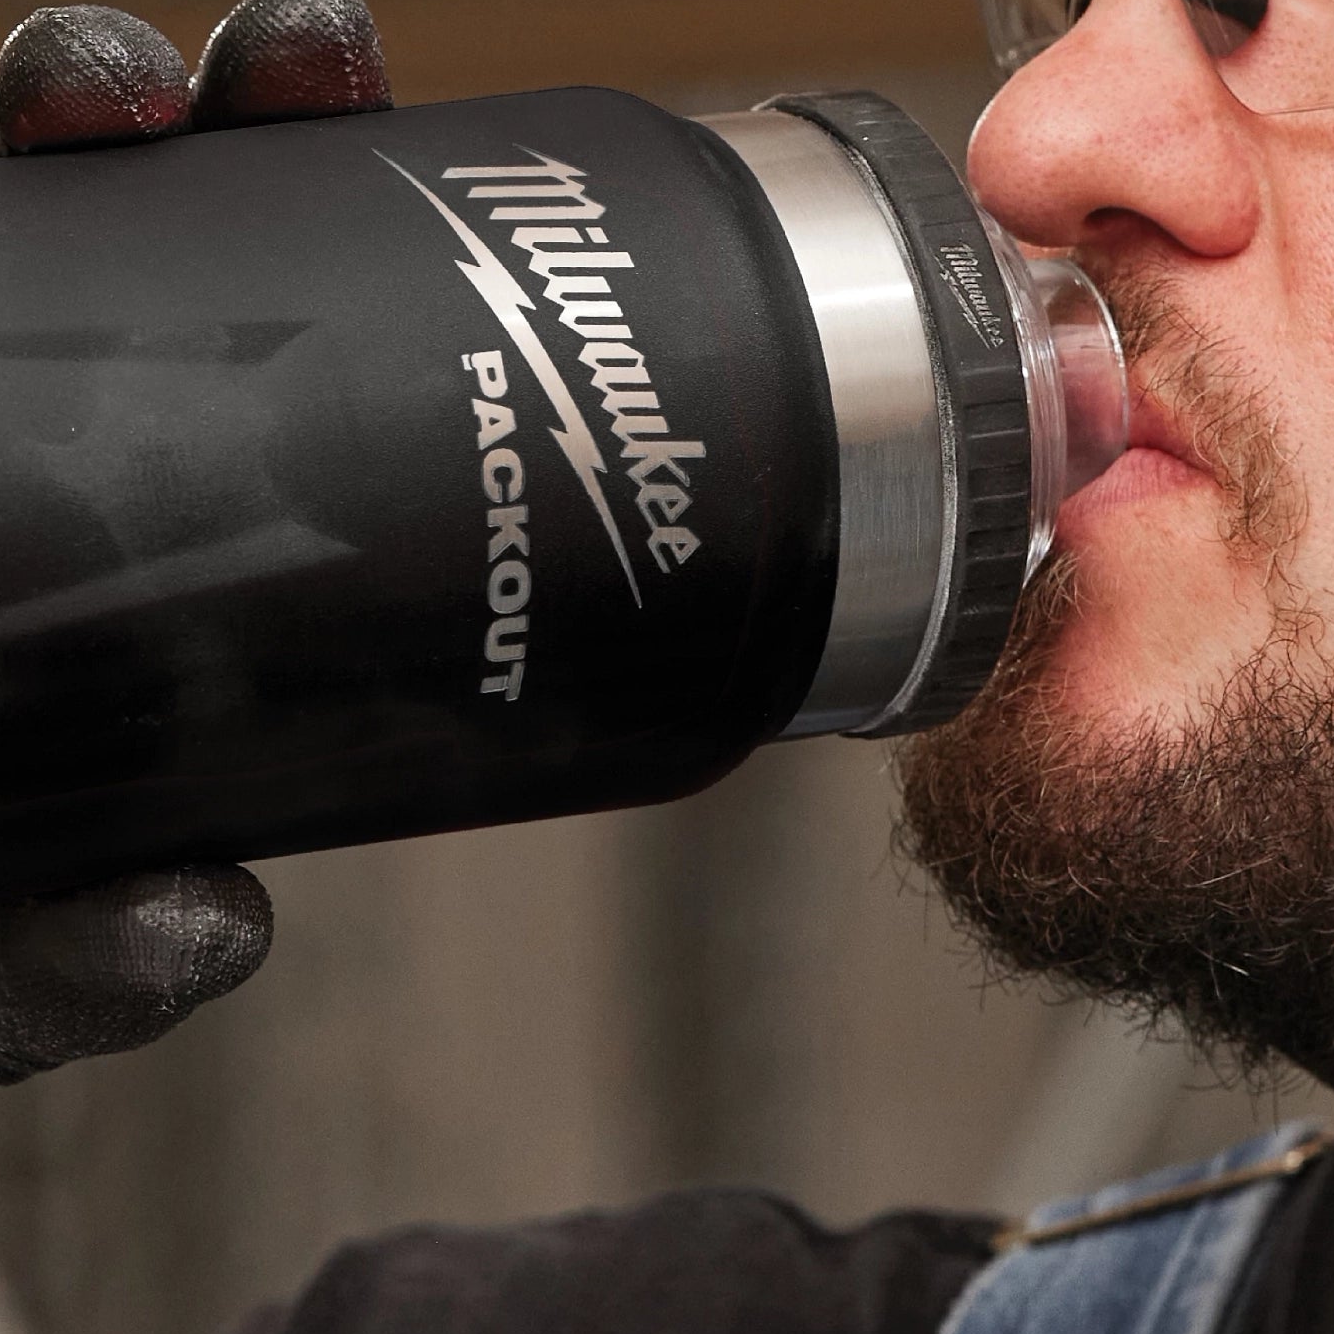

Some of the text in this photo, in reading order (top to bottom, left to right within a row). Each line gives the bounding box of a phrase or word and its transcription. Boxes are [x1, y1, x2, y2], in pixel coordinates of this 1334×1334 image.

[440, 141, 707, 574] Milwaukee
[939, 243, 1004, 348] Milwaukee
[461, 349, 532, 702] PACKOUT
